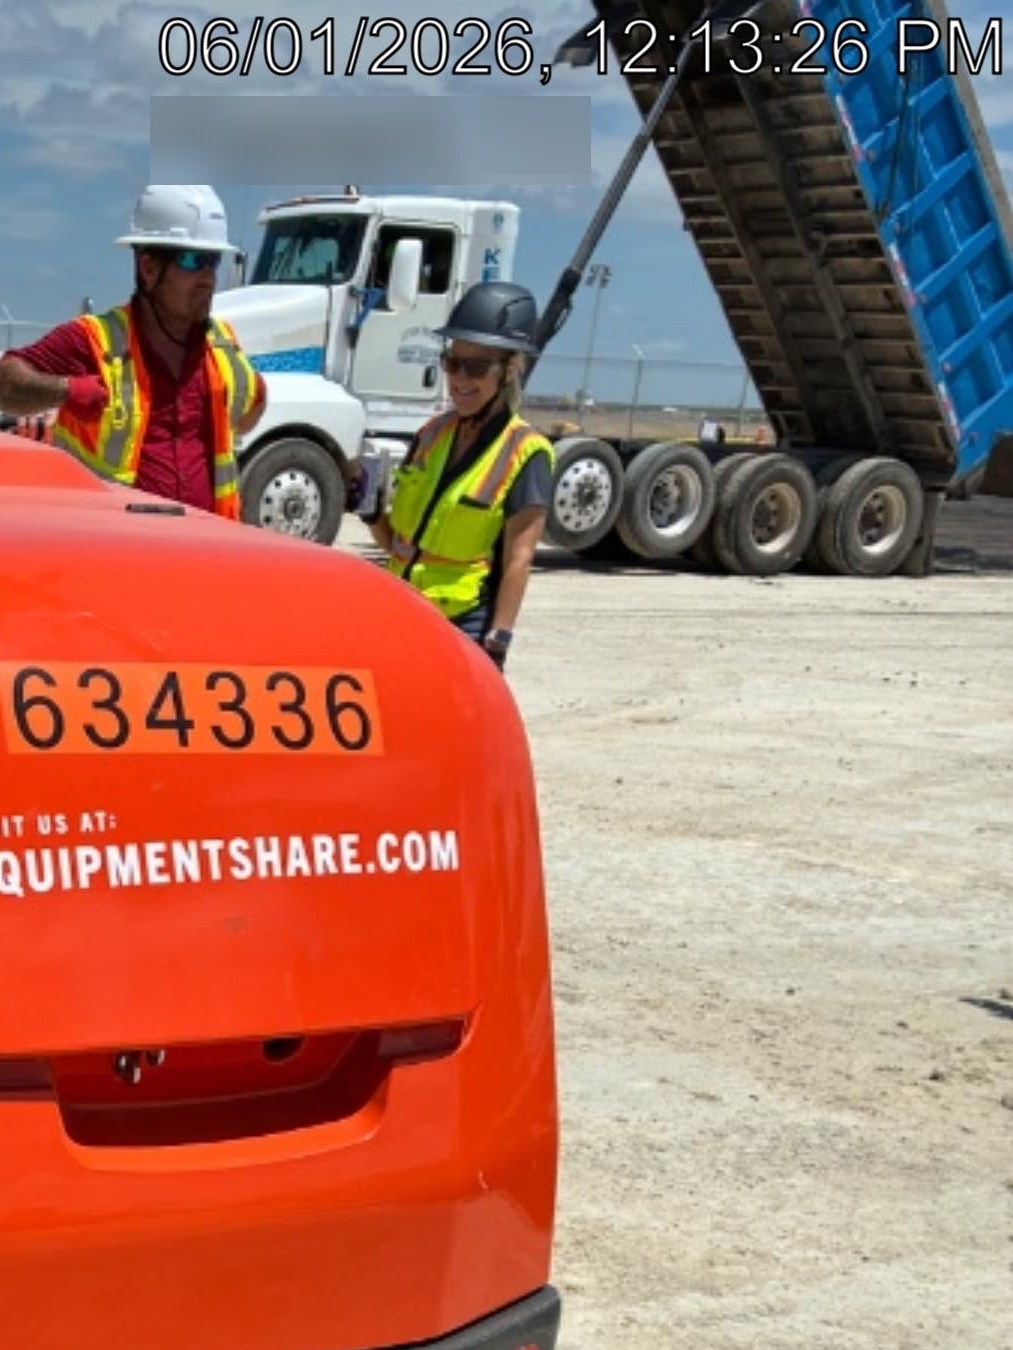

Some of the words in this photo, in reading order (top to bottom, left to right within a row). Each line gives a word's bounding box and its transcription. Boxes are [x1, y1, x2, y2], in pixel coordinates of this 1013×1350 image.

[12, 666, 374, 752] 634336
[37, 814, 68, 836] US
[79, 811, 118, 833] AT:
